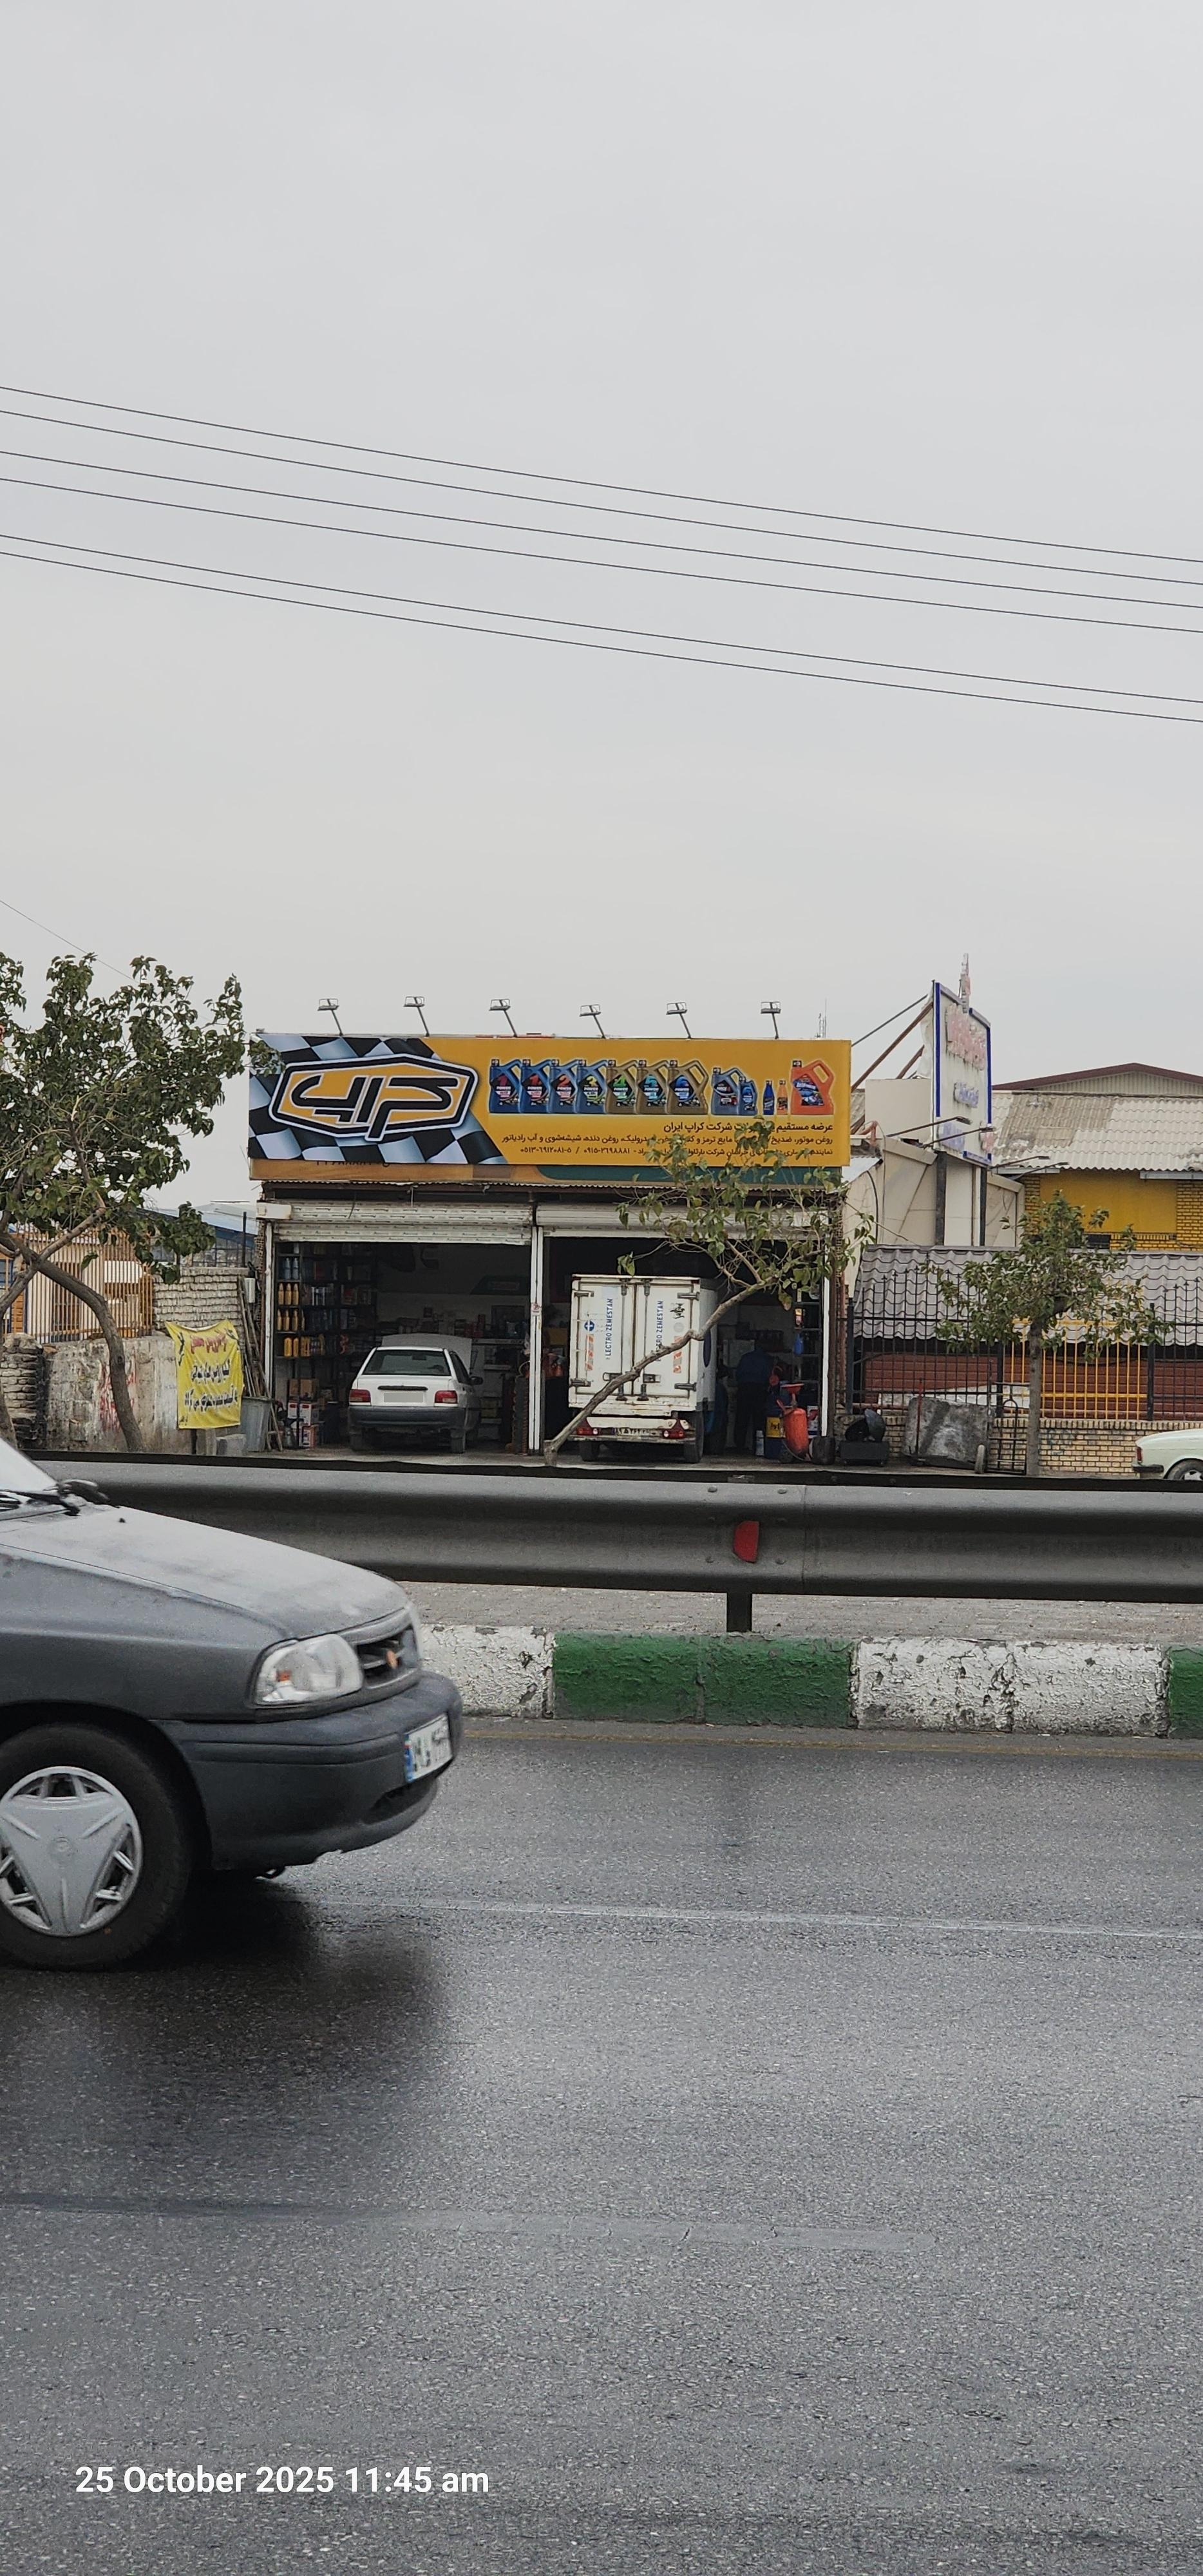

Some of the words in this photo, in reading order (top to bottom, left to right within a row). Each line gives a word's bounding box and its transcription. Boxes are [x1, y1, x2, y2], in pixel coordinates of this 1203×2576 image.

[558, 1075, 569, 1087] 2
[586, 1075, 598, 1087] 3
[663, 1122, 683, 1132] ایران
[685, 1122, 705, 1133] کراپ
[706, 1122, 732, 1133] شرکت
[776, 1122, 810, 1133] مستقیم
[811, 1123, 833, 1133] عرضه
[502, 1134, 526, 1142] رادیاتور
[527, 1133, 537, 1142] آب
[602, 1135, 619, 1144] روغن
[701, 1136, 716, 1144] ترمز
[717, 1136, 733, 1144] مایع
[815, 1136, 833, 1144] روغن
[706, 1148, 725, 1157] شرکت
[656, 1300, 664, 1333] ZEMESTAN
